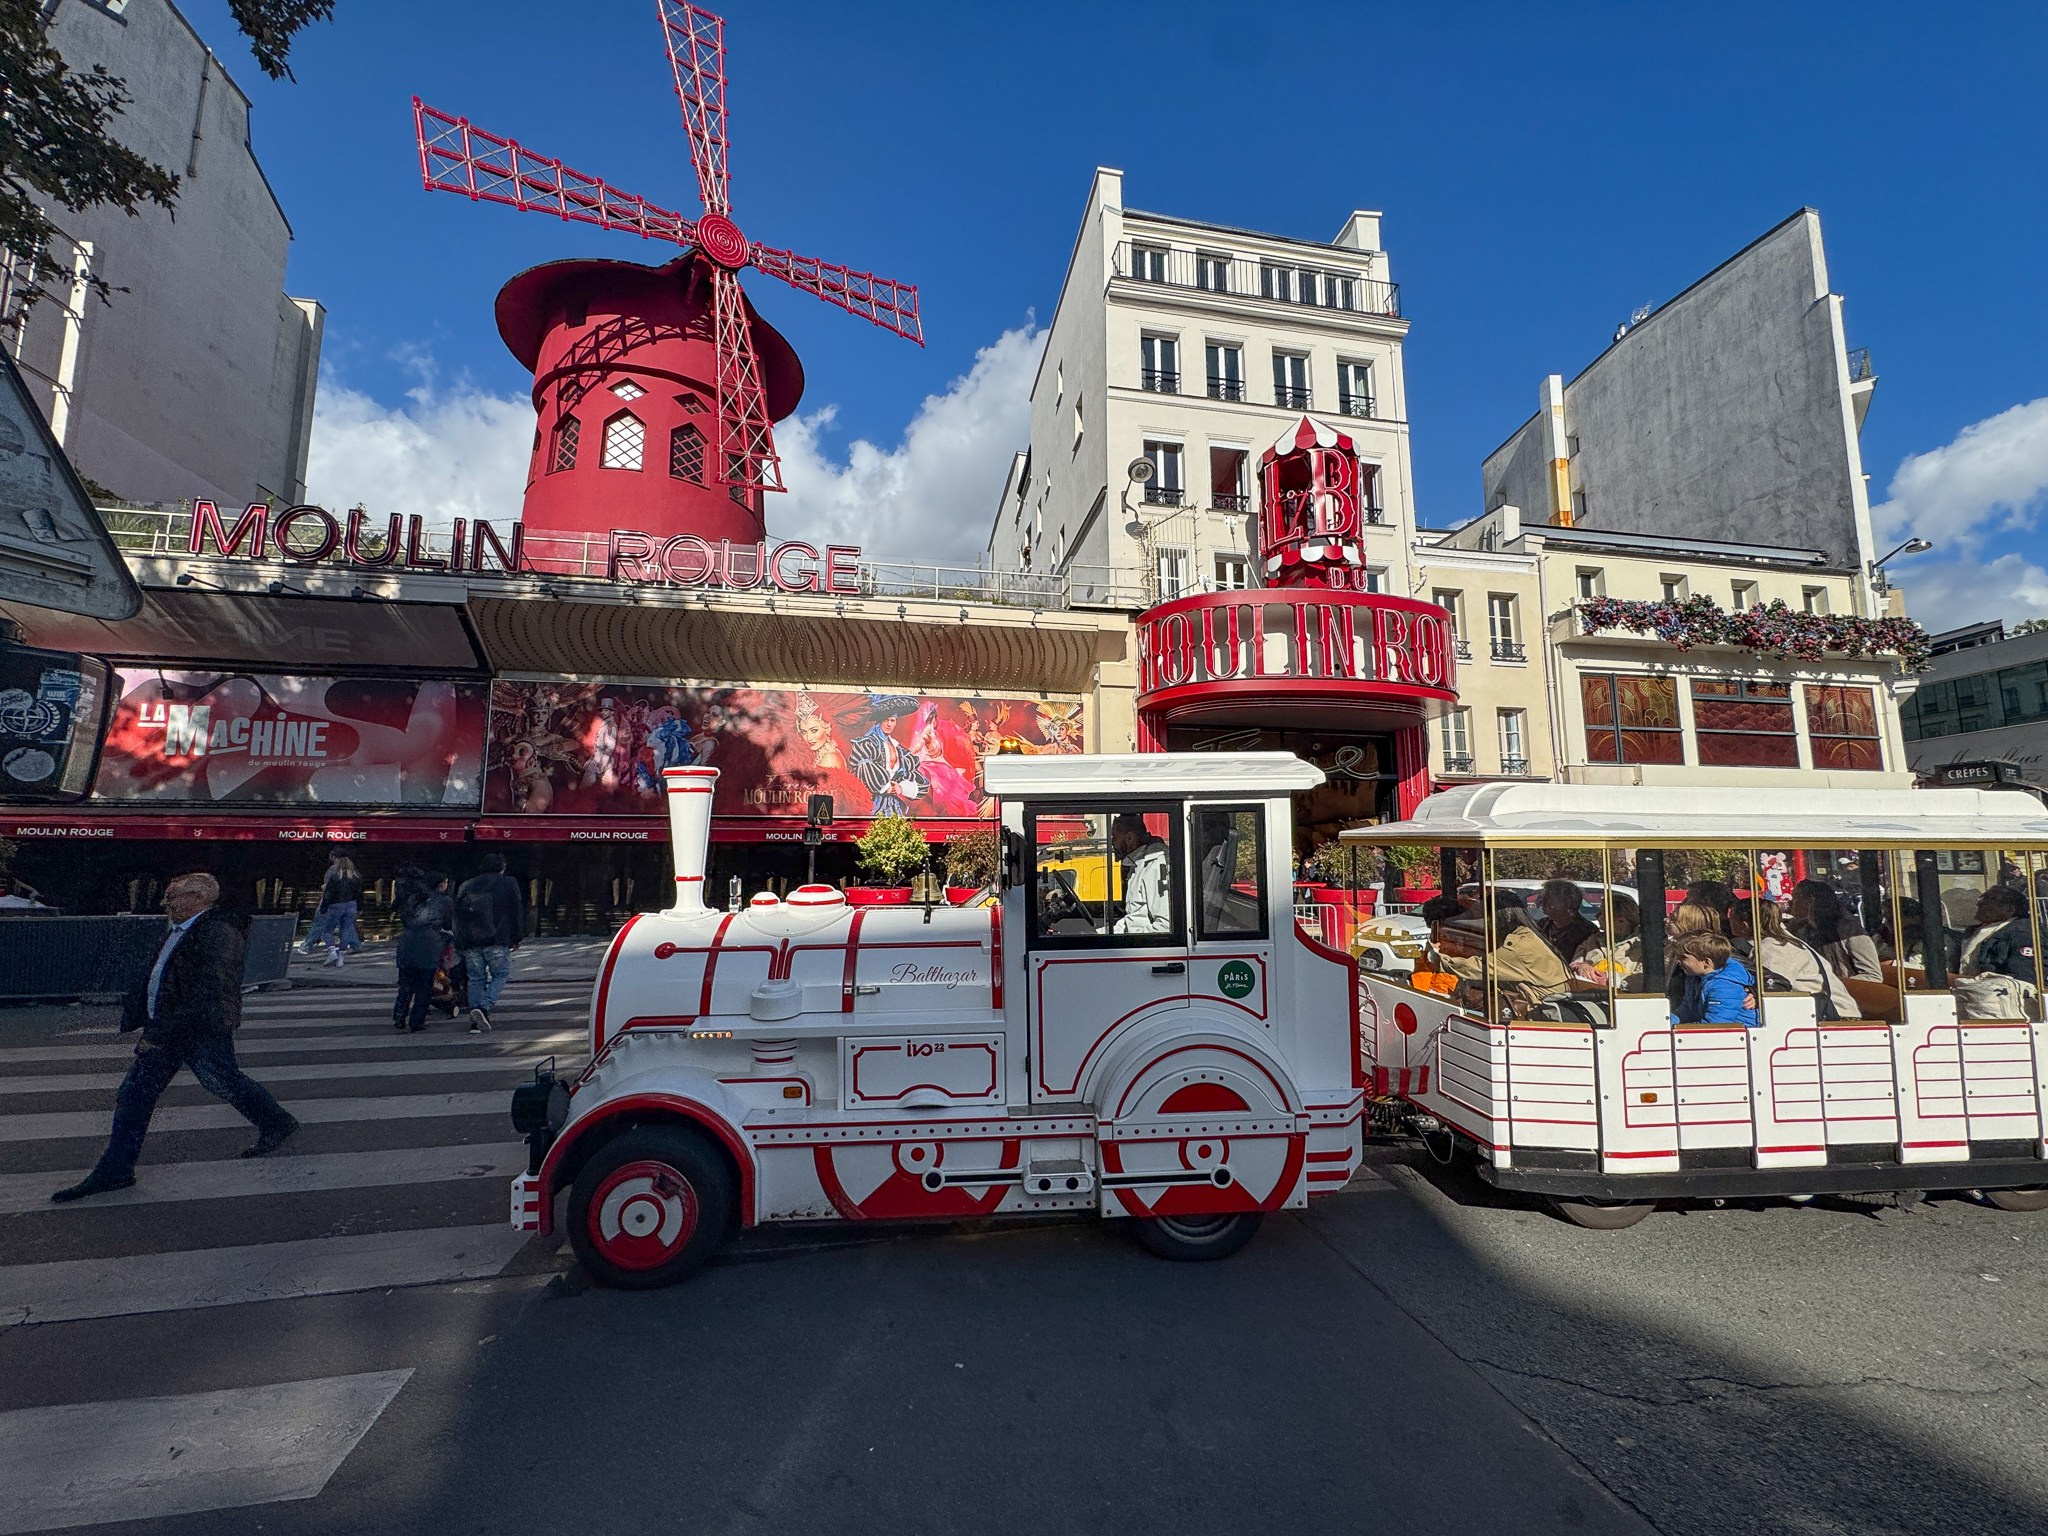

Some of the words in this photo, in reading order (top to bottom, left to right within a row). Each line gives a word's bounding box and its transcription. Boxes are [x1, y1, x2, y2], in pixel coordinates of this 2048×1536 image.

[188, 498, 525, 573] MOULIN
[607, 529, 862, 594] ROUGE
[1329, 566, 1369, 590] DU
[1137, 603, 1355, 694] MOULIN
[139, 703, 165, 721] LA
[744, 788, 791, 805] MOULIN
[16, 827, 67, 836] MOULIN
[69, 828, 115, 837] ROUGE
[278, 830, 324, 839] MOULIN
[326, 831, 367, 840] ROUGE
[570, 831, 611, 840] MOULIN
[612, 832, 649, 840] ROUGE
[889, 963, 978, 990] Balthazar
